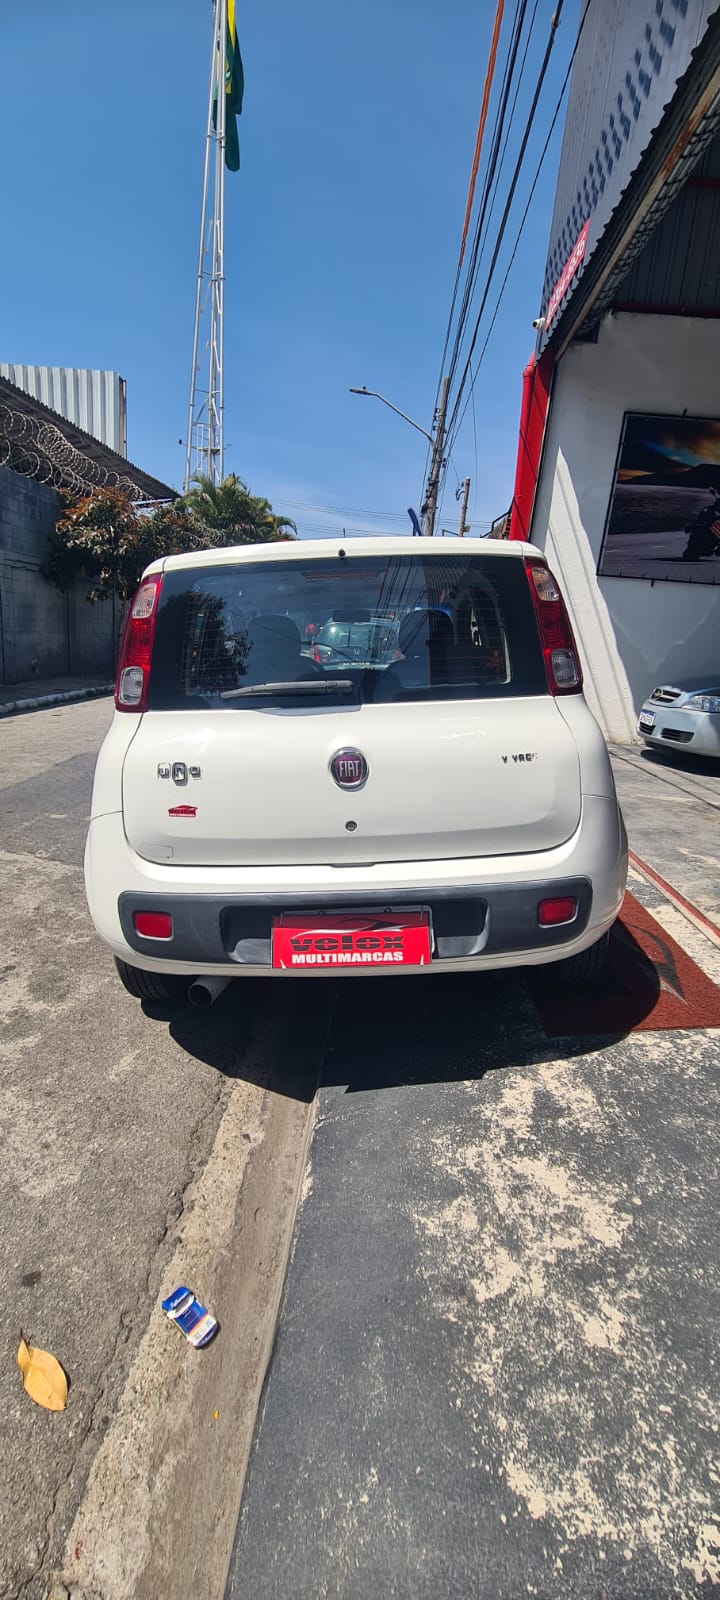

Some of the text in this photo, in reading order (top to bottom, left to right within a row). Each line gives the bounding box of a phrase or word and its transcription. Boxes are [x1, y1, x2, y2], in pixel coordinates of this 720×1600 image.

[501, 752, 538, 764] VVAC
[339, 760, 360, 777] FIAT
[291, 951, 404, 964] MULTIMARCAS
